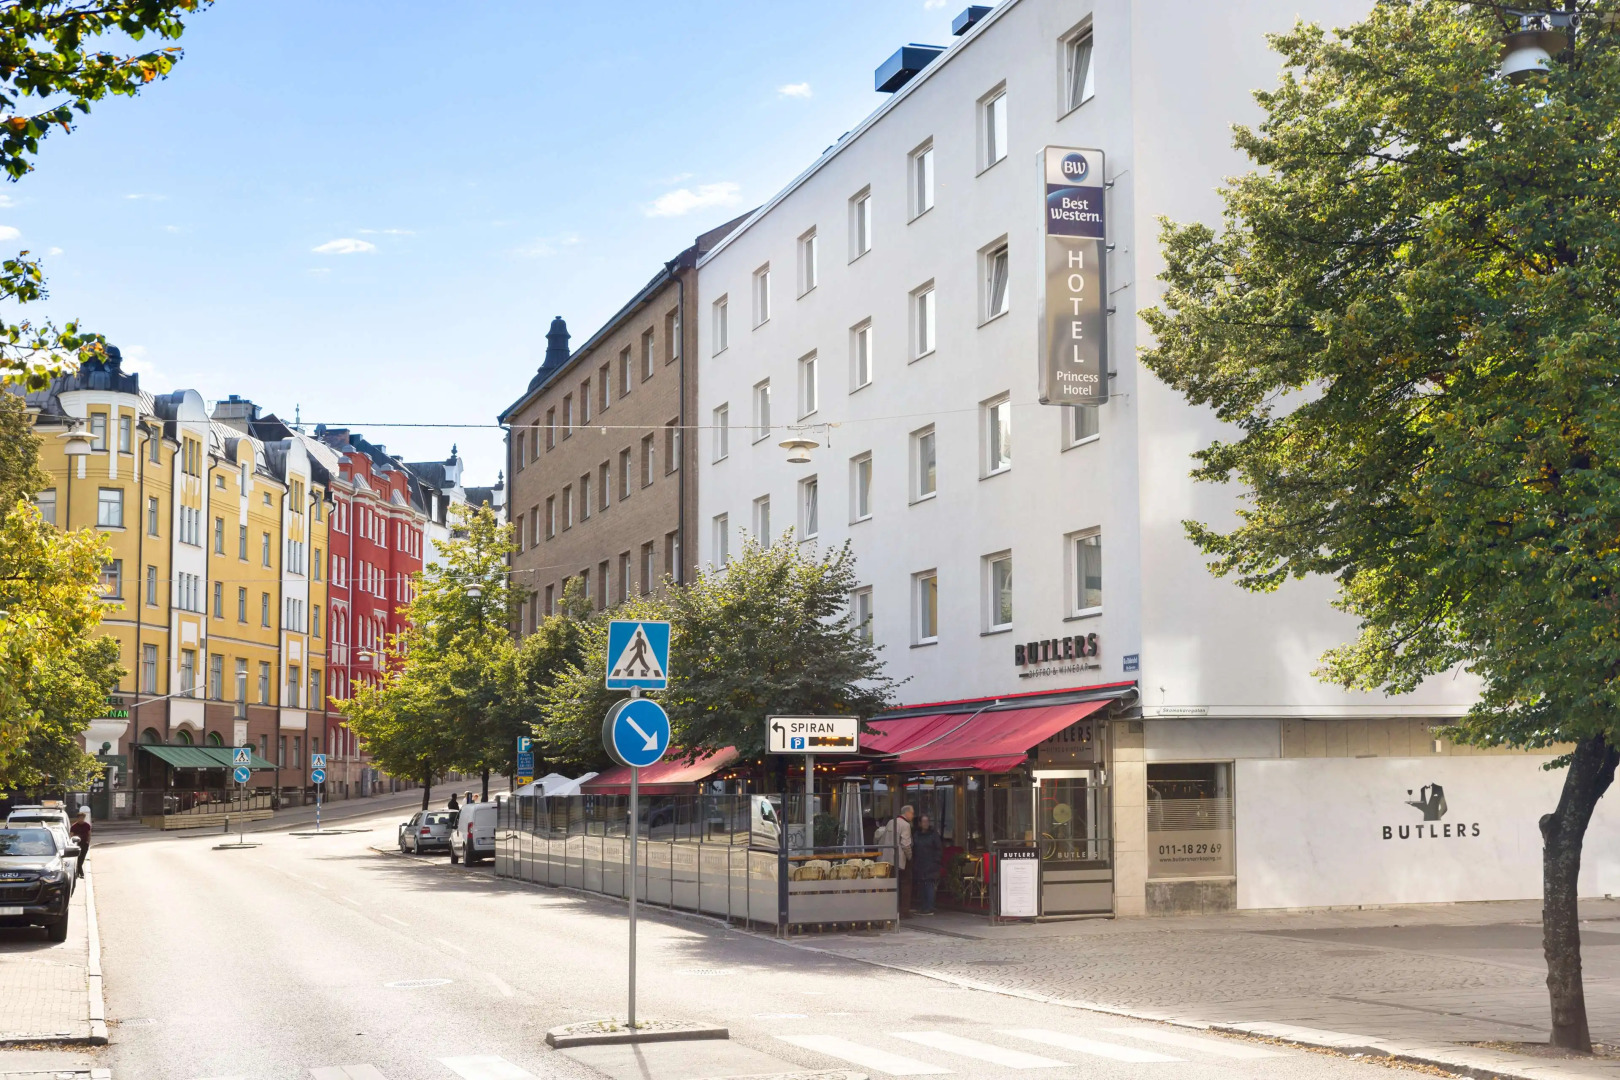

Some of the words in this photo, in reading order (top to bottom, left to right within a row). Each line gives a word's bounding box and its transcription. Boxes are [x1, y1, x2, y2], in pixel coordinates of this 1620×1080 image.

[1064, 161, 1086, 174] BW
[1062, 197, 1089, 210] Best
[1050, 208, 1100, 222] Western
[1067, 250, 1085, 363] HOTEL
[1056, 371, 1099, 382] Princess
[1063, 384, 1092, 396] Hotel
[1014, 632, 1099, 667] BUTLERS
[1028, 667, 1051, 679] BISTRO
[1058, 662, 1089, 674] WINEBAR
[106, 696, 124, 705] TEL
[790, 722, 834, 733] SPIRAN
[1382, 822, 1481, 840] BUTLERS
[1057, 851, 1098, 859] BUTLES
[1159, 844, 1194, 855] 011-18
[1196, 843, 1208, 854] 29
[1210, 843, 1222, 854] 69
